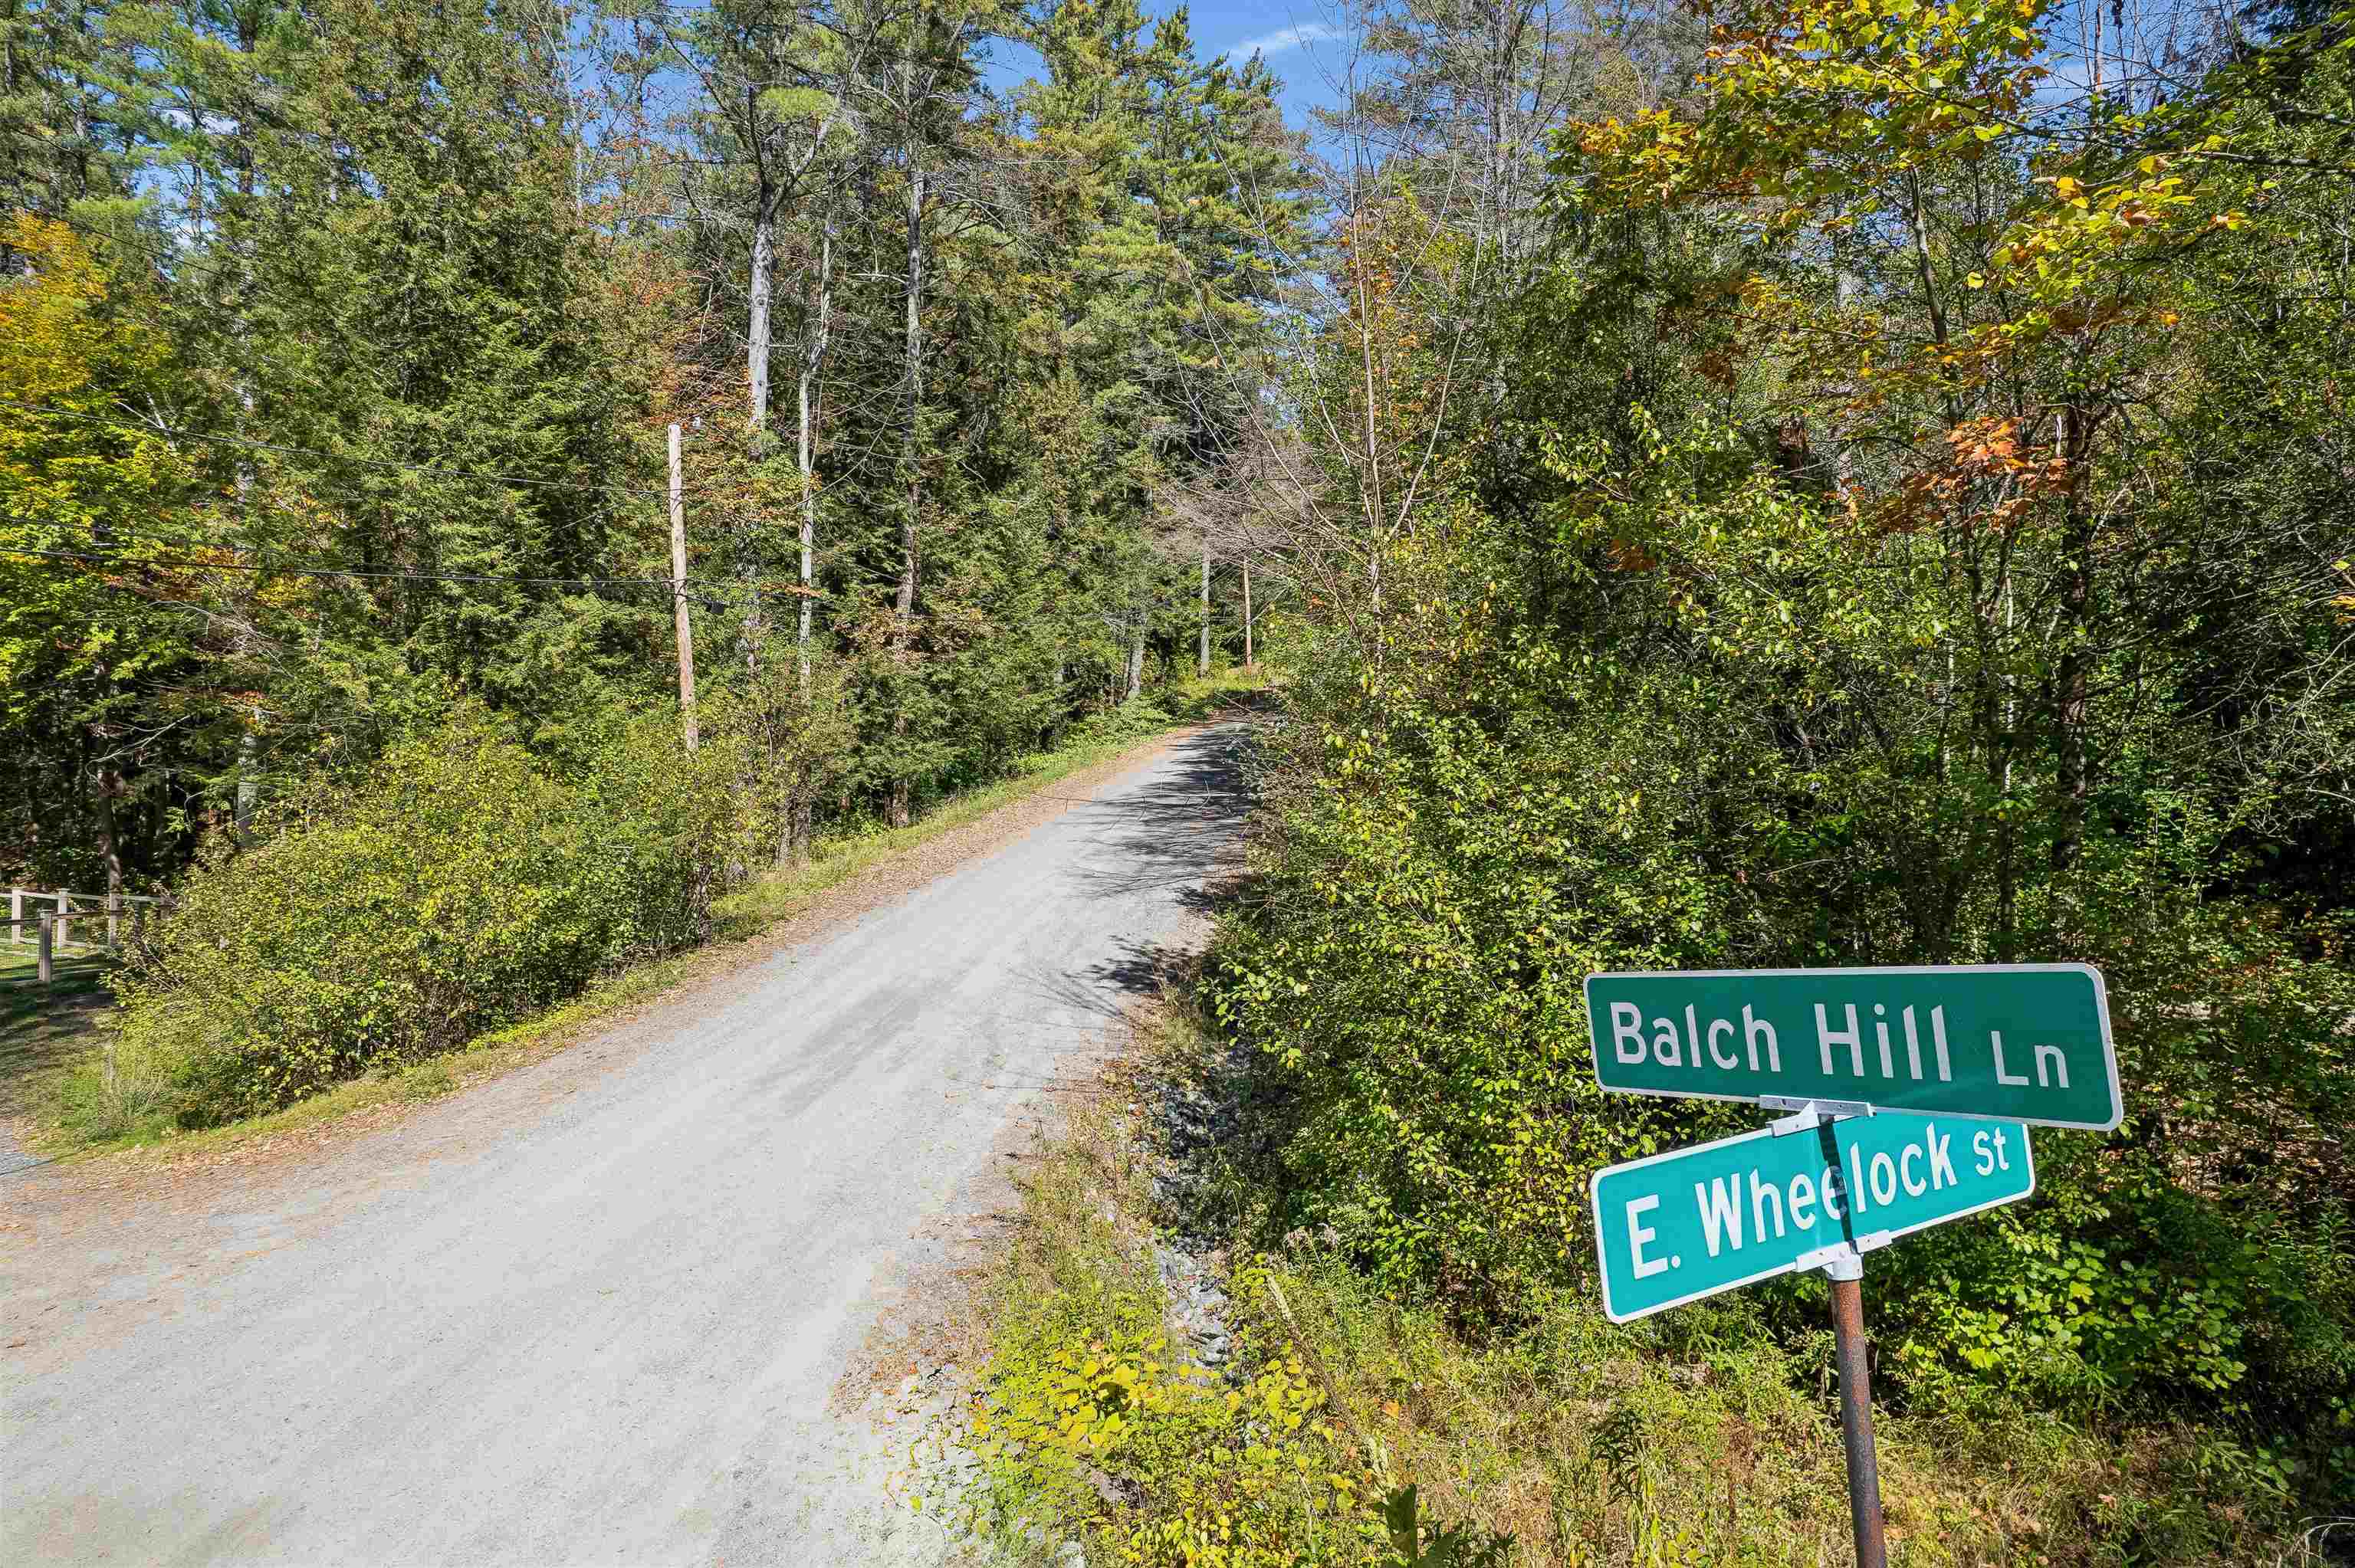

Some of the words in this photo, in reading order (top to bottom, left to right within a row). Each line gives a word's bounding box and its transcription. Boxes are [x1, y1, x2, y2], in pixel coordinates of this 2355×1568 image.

[1611, 1002, 1780, 1071] Balch
[1815, 1004, 1951, 1081] Hill
[1992, 1032, 2068, 1087] Ln
[1626, 1195, 1681, 1279] E.
[1695, 1122, 1957, 1257] Wheelock
[1974, 1127, 2008, 1175] St
